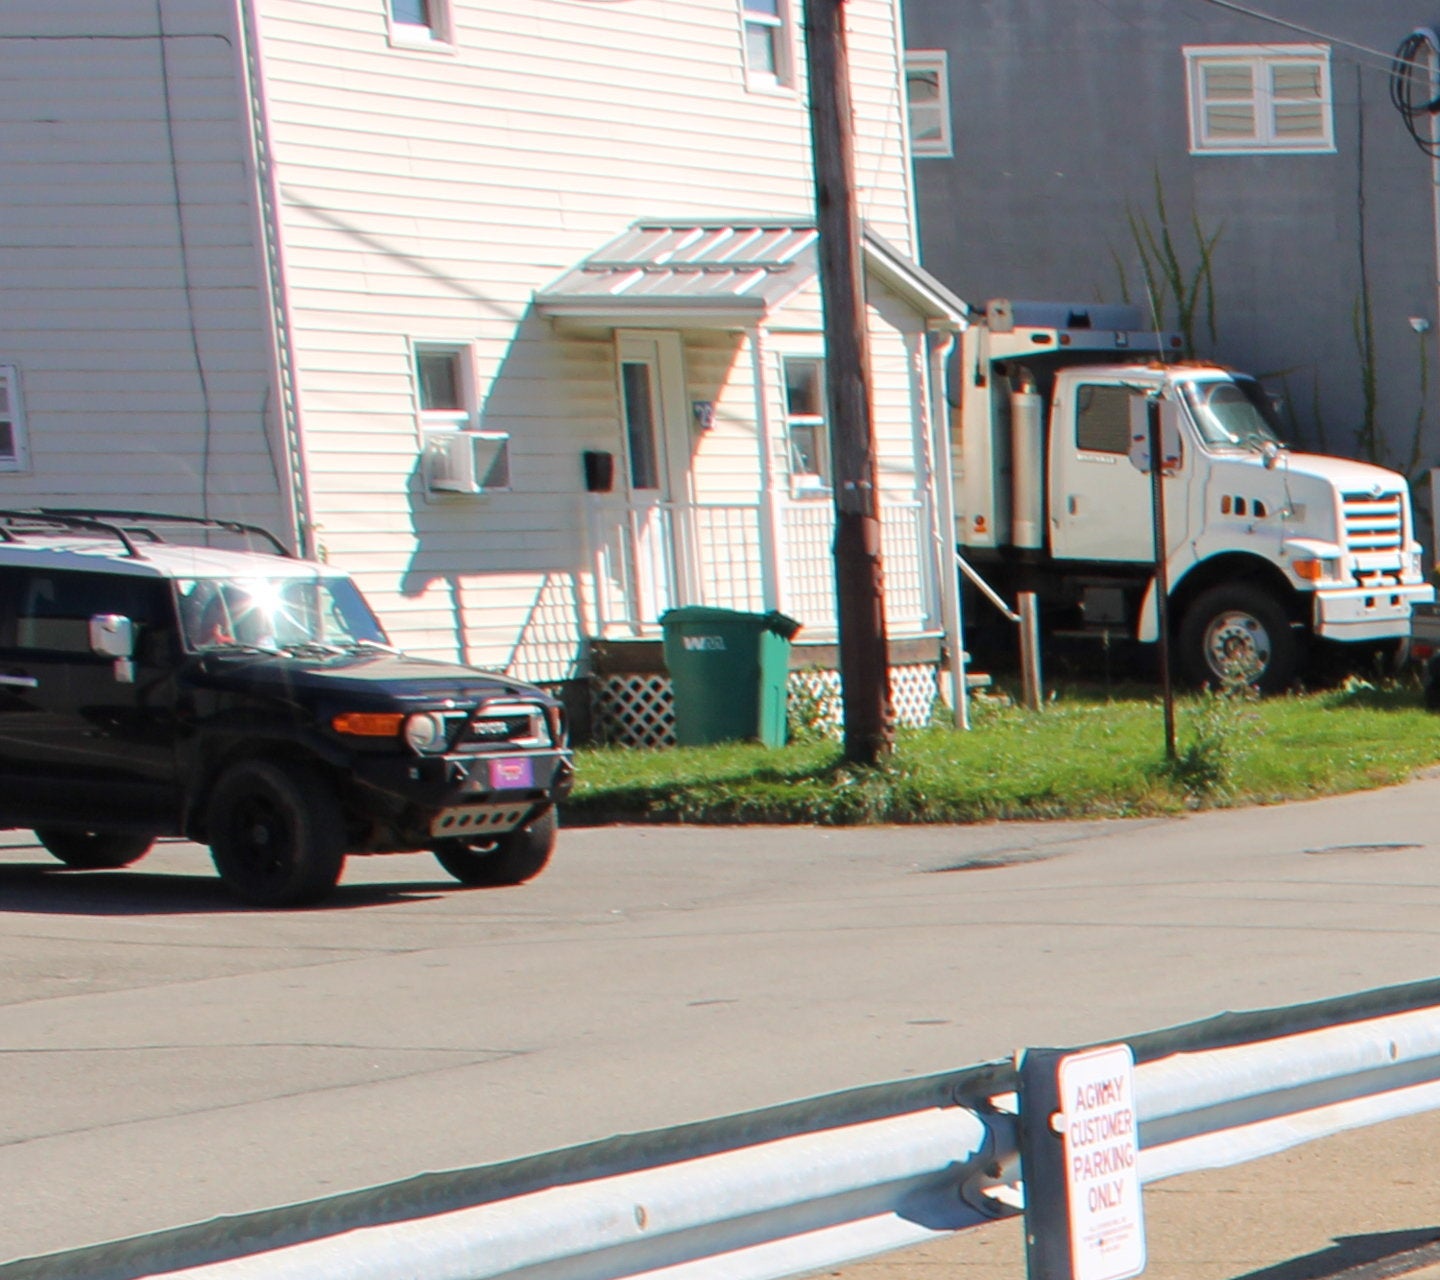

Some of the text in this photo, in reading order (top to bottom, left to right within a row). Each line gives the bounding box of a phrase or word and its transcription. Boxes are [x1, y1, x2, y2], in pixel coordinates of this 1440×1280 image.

[1075, 1075, 1125, 1113] AGWAY
[1070, 1110, 1134, 1148] CUSTOMER
[1073, 1142, 1135, 1183] PARKING
[1087, 1179, 1125, 1213] ONLY
